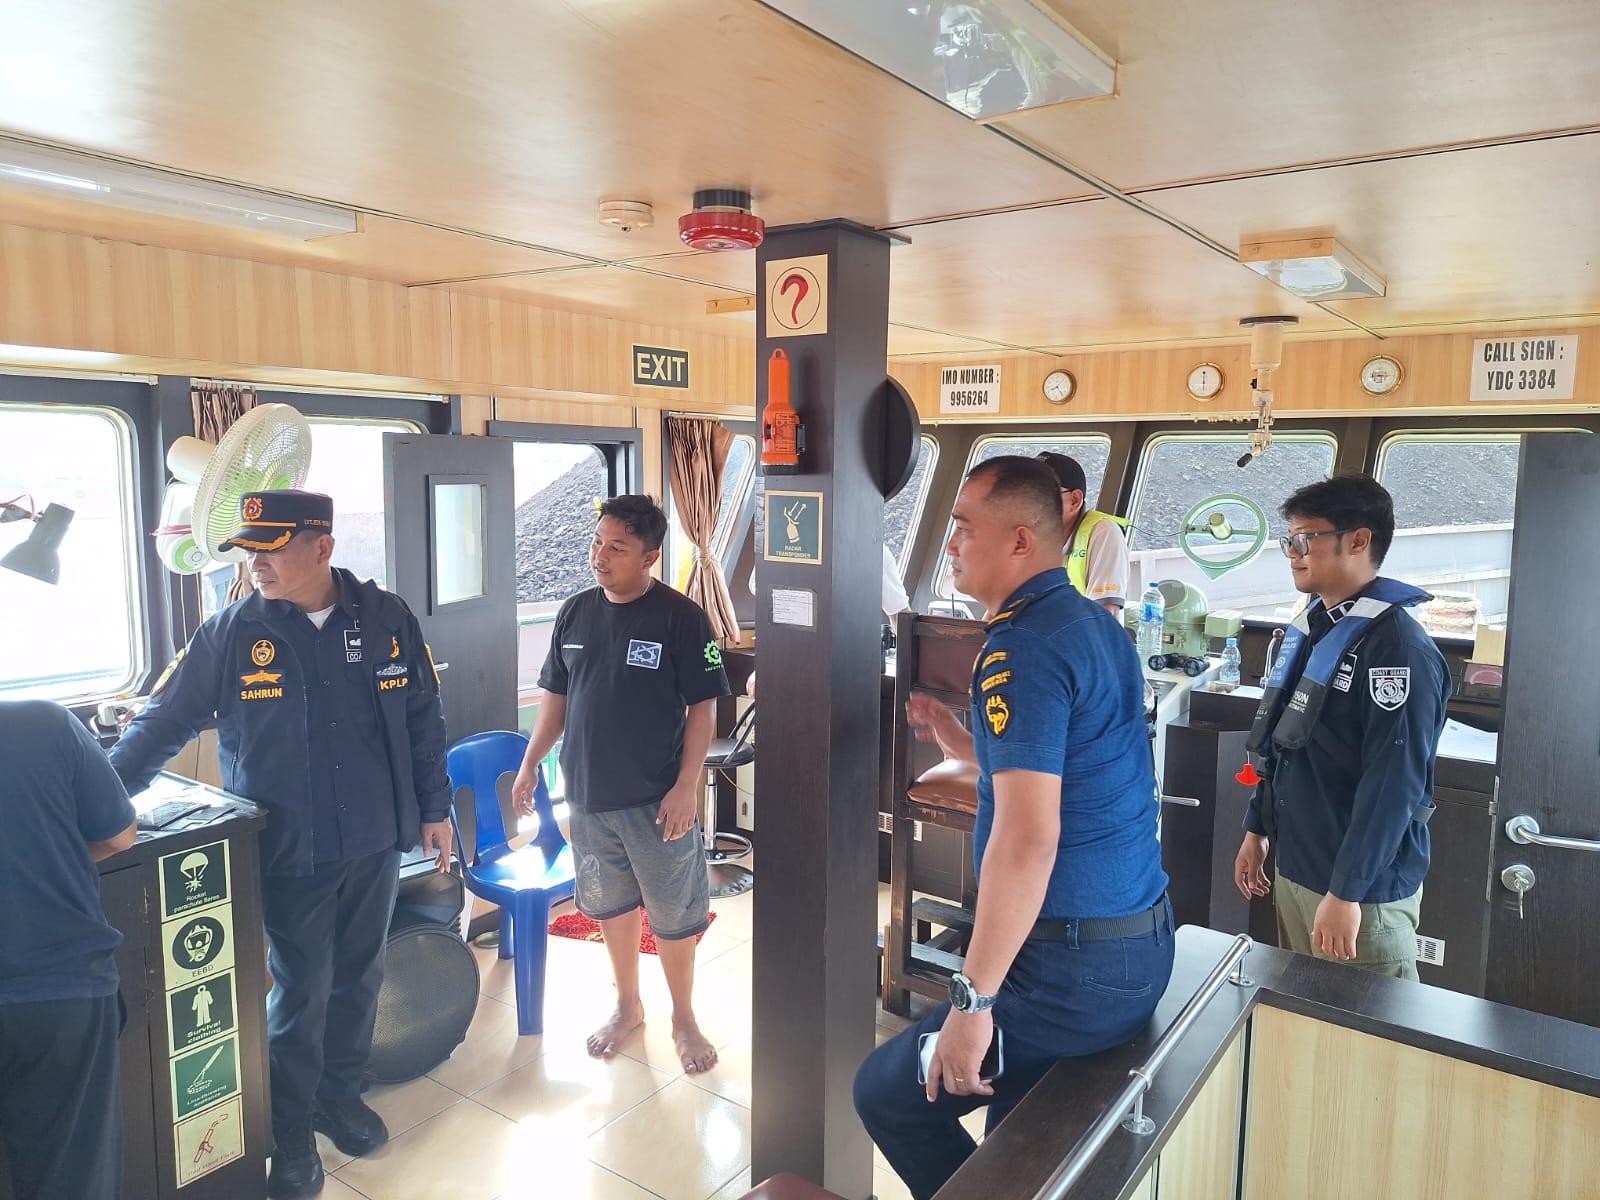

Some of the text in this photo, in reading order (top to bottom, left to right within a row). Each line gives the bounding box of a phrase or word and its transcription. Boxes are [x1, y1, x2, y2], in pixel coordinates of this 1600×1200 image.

[1483, 341, 1516, 363] CALL
[1520, 340, 1556, 361] SIGN
[636, 352, 686, 382] EXIT
[942, 369, 958, 385] IMO
[960, 368, 994, 384] NUMBER
[1487, 368, 1556, 391] YDC 3384
[950, 390, 988, 406] 9956264
[380, 678, 409, 690] KPLP
[240, 687, 283, 700] SAHRUN
[173, 894, 220, 914] parachute flares
[186, 891, 207, 902] Rocket
[191, 964, 214, 978] EEBD
[186, 1019, 221, 1038] Survival
[187, 1027, 222, 1044] clothing
